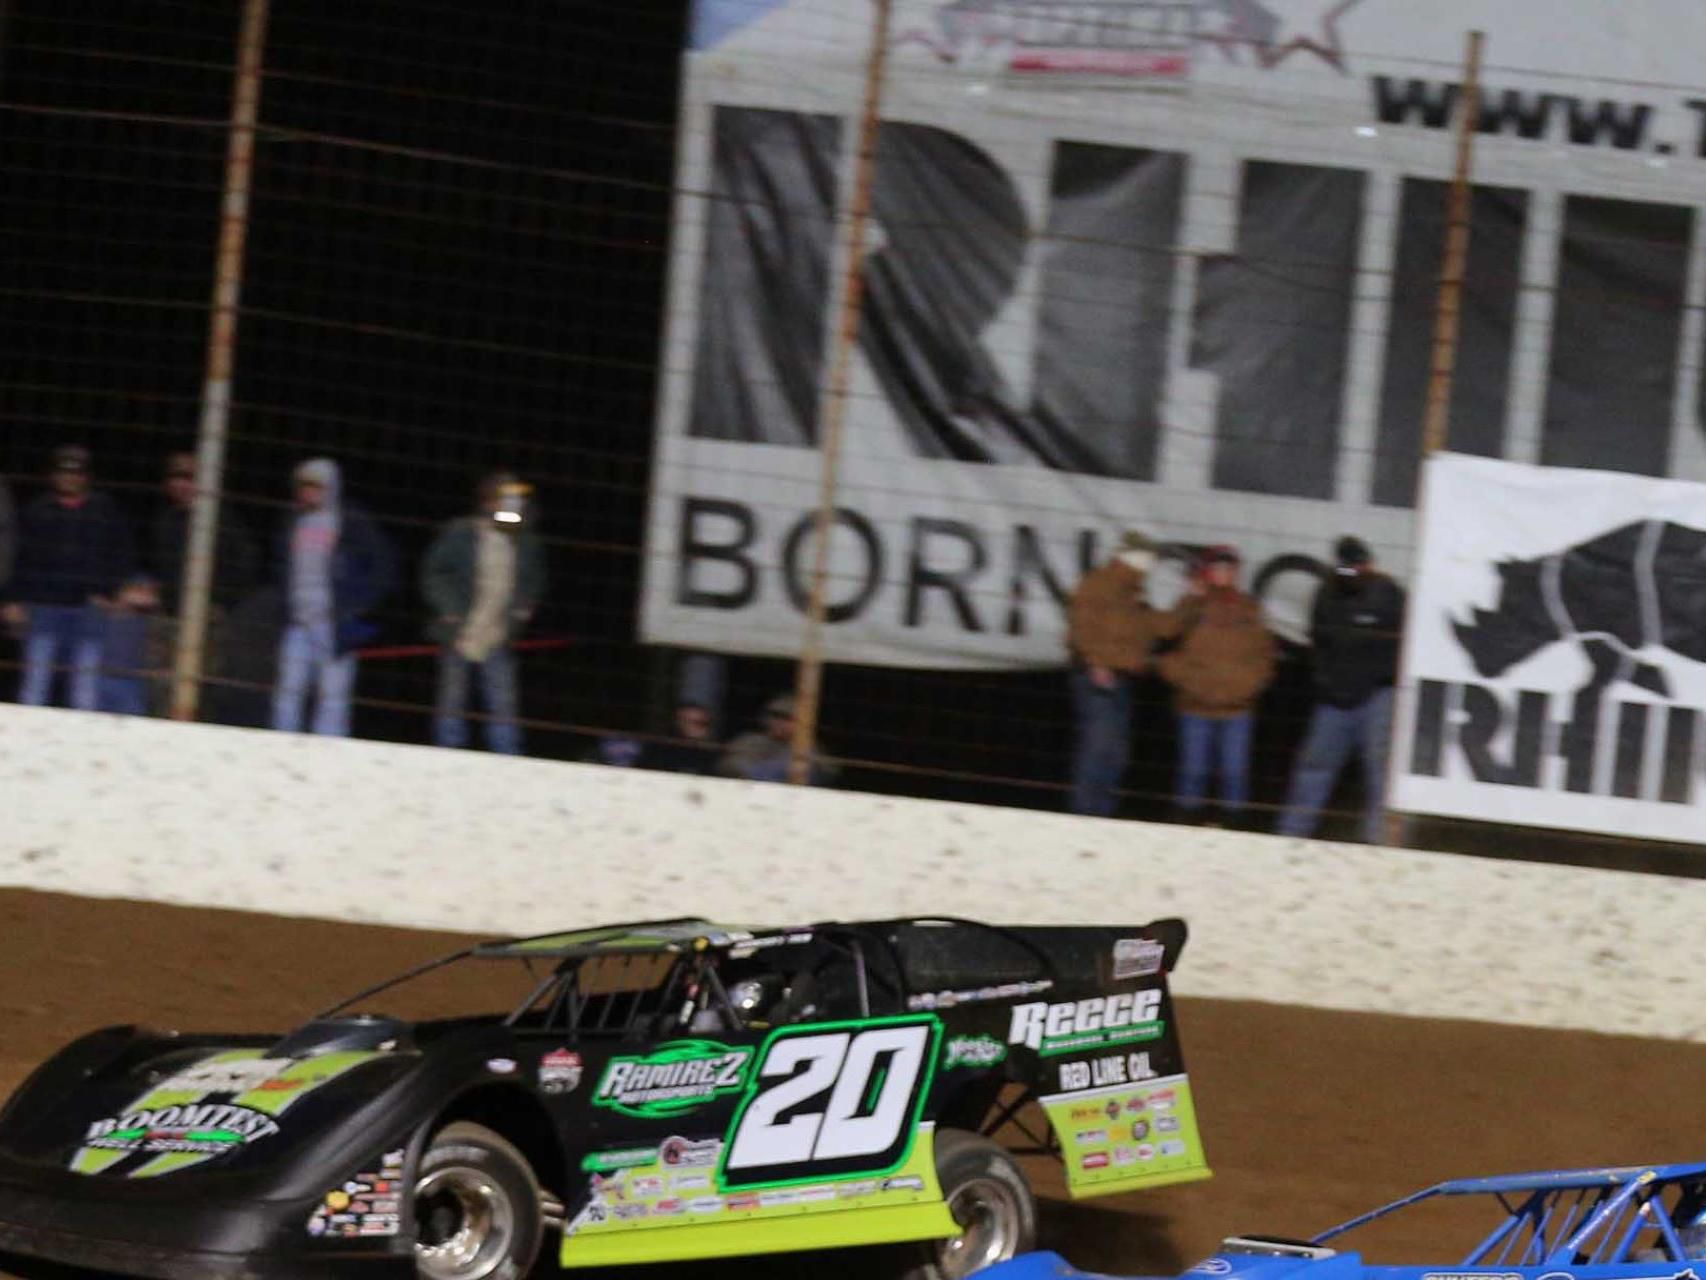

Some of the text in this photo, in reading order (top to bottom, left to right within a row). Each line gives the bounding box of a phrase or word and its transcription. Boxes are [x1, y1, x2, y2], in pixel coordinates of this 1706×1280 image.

[672, 496, 1098, 638] BORN
[599, 1052, 750, 1098] RAMIREZ
[727, 1024, 930, 1169] 20
[1059, 1062, 1091, 1091] RED
[1092, 1056, 1126, 1087] LINE
